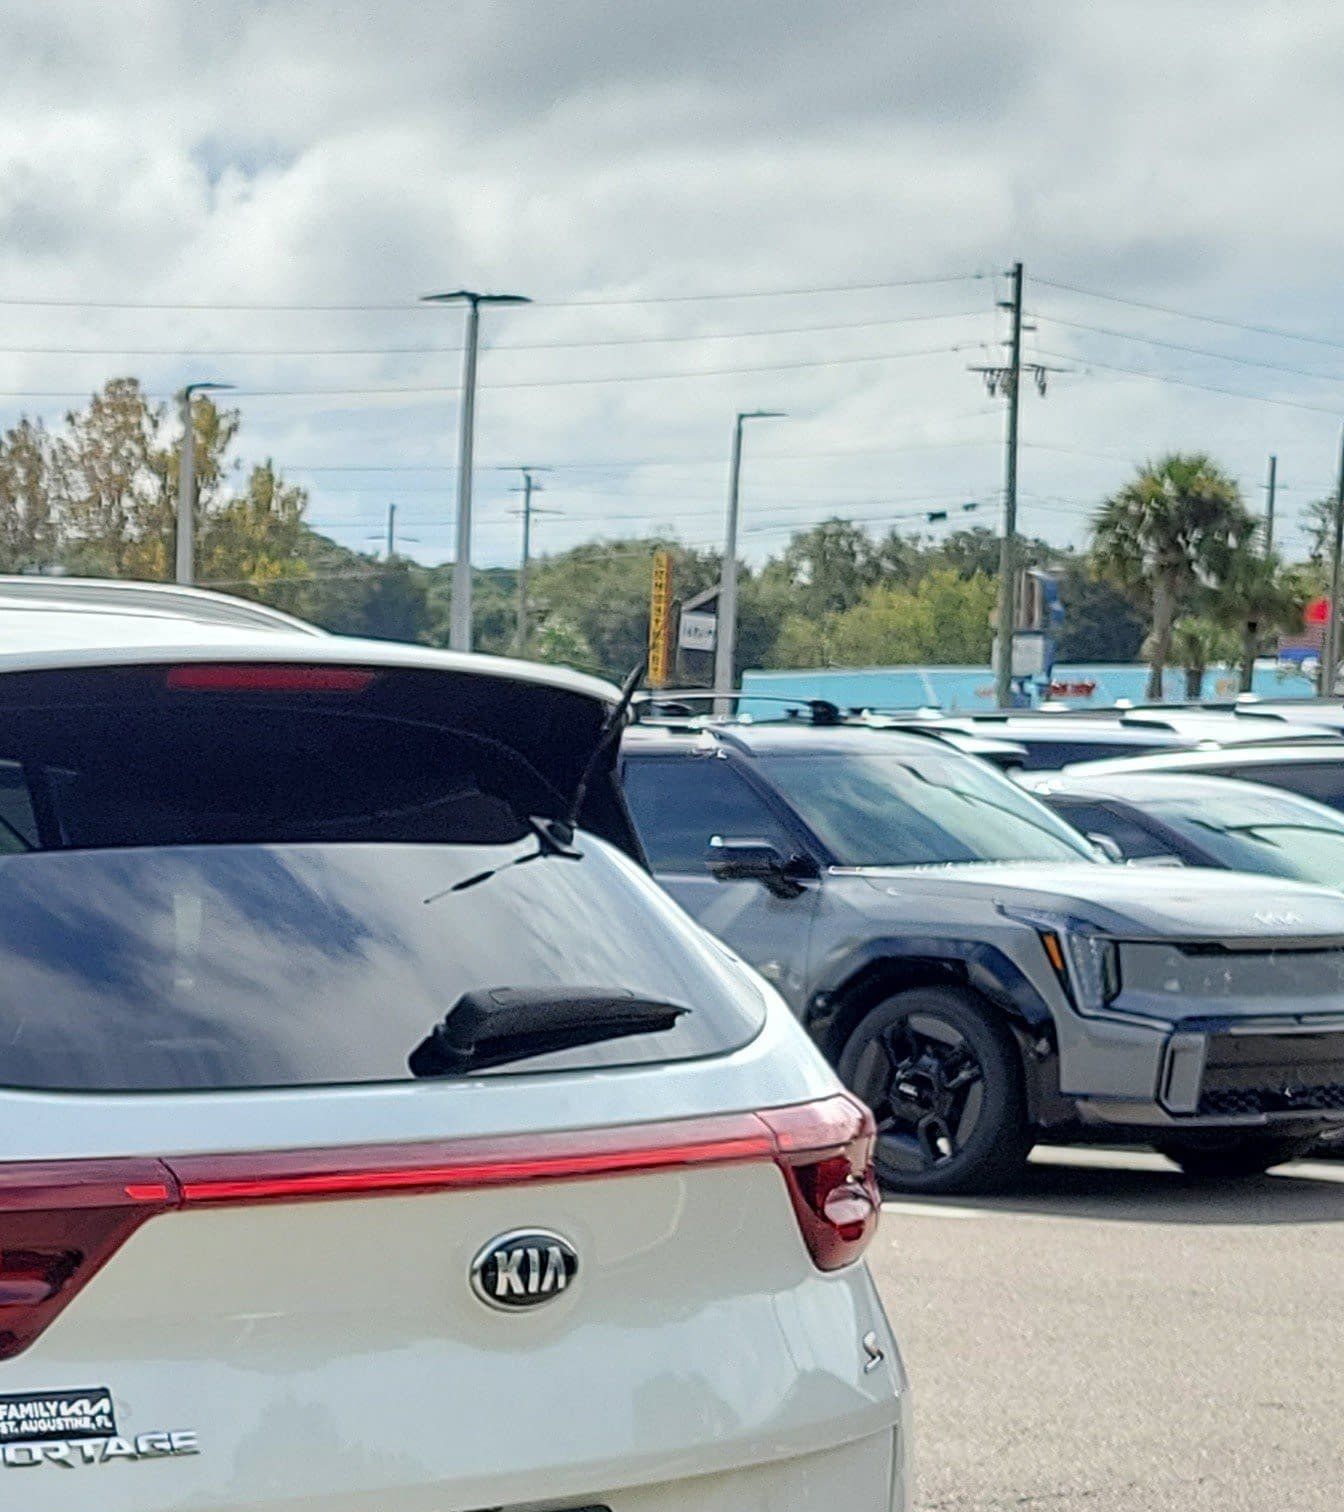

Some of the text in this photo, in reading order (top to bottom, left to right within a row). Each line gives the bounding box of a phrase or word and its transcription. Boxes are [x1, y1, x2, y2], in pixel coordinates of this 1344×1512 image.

[494, 1246, 566, 1297] KIA
[863, 1330, 884, 1375] S
[60, 1398, 111, 1417] KIA
[96, 1415, 113, 1429] FL
